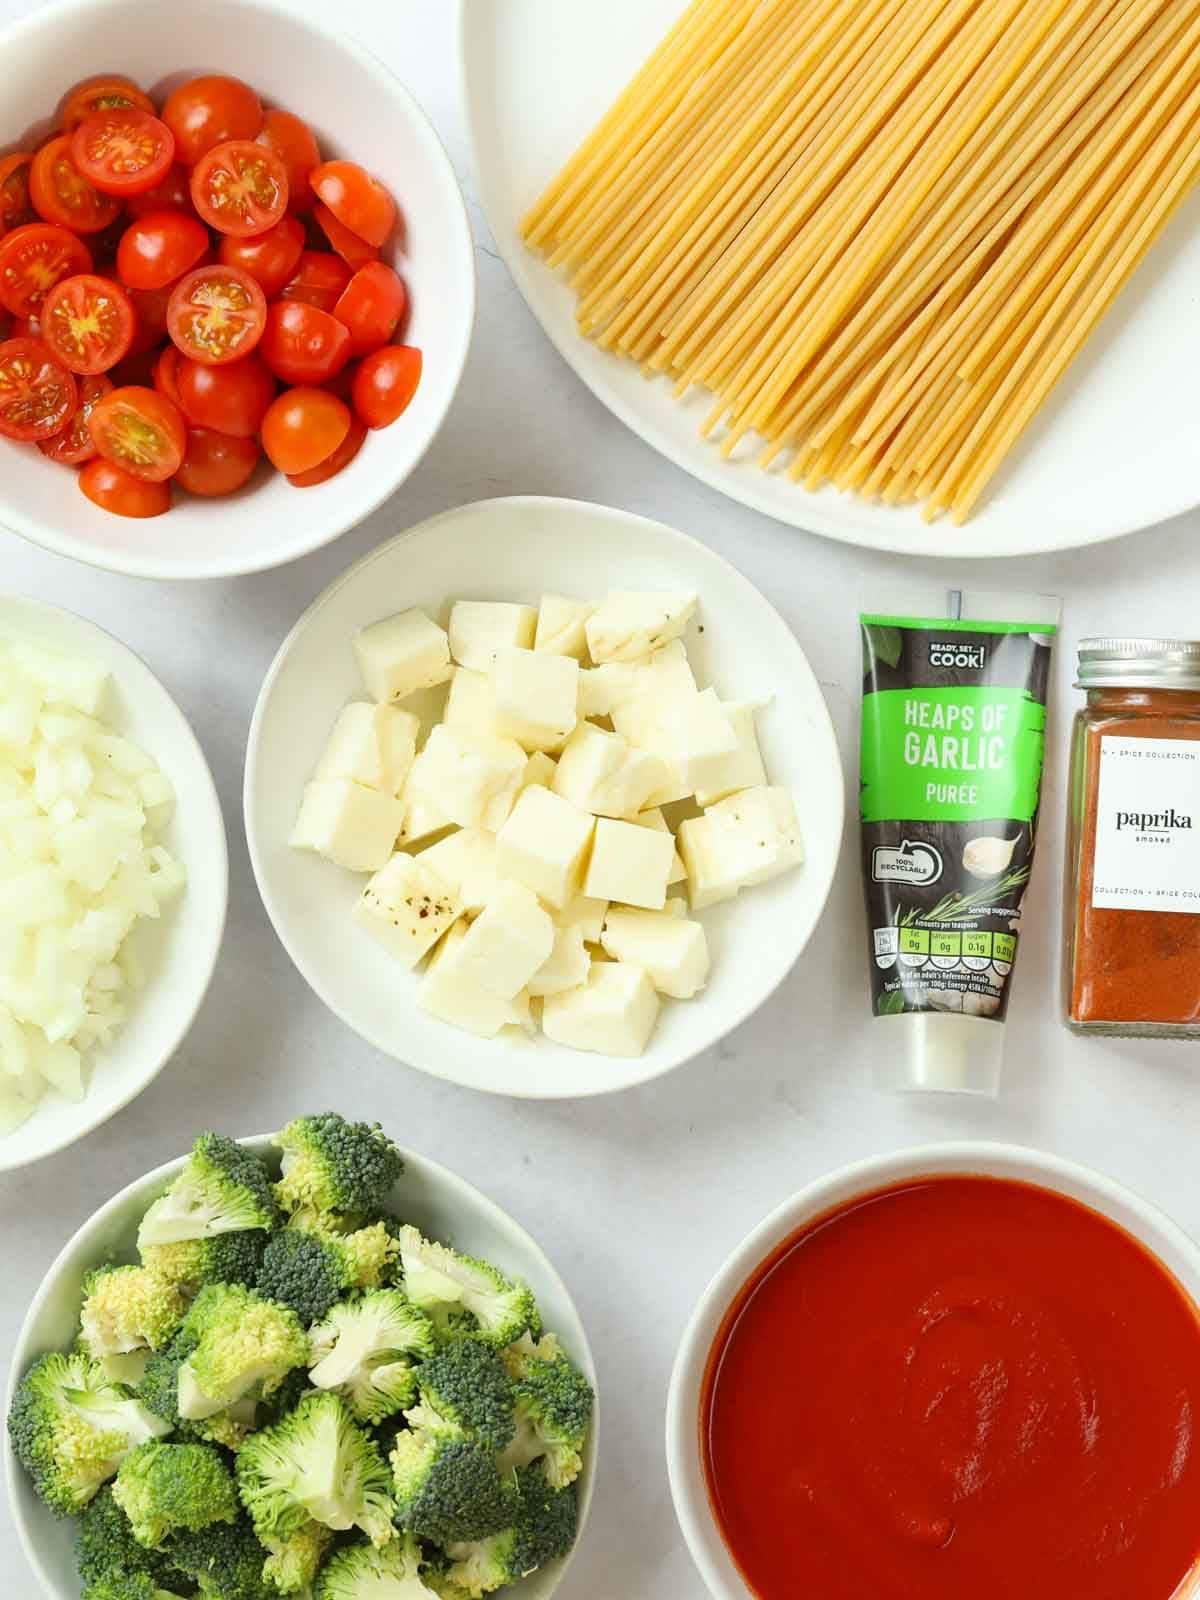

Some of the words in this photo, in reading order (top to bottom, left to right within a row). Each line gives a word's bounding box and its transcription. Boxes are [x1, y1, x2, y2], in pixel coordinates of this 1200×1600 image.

[930, 646, 985, 668] COOK!
[904, 700, 974, 732] HEAPS
[981, 703, 1008, 732] OF
[904, 731, 1006, 770] GARLIC
[1146, 751, 1196, 760] COLLECTION
[926, 782, 977, 804] PURÉE
[1116, 809, 1192, 831] paprika
[895, 858, 914, 866] 100%
[880, 864, 928, 874] RECYCLABLE
[1094, 886, 1144, 895] COLLECTION
[909, 940, 920, 950] 0g
[940, 942, 951, 952] 0g
[968, 943, 985, 953] 0.1g
